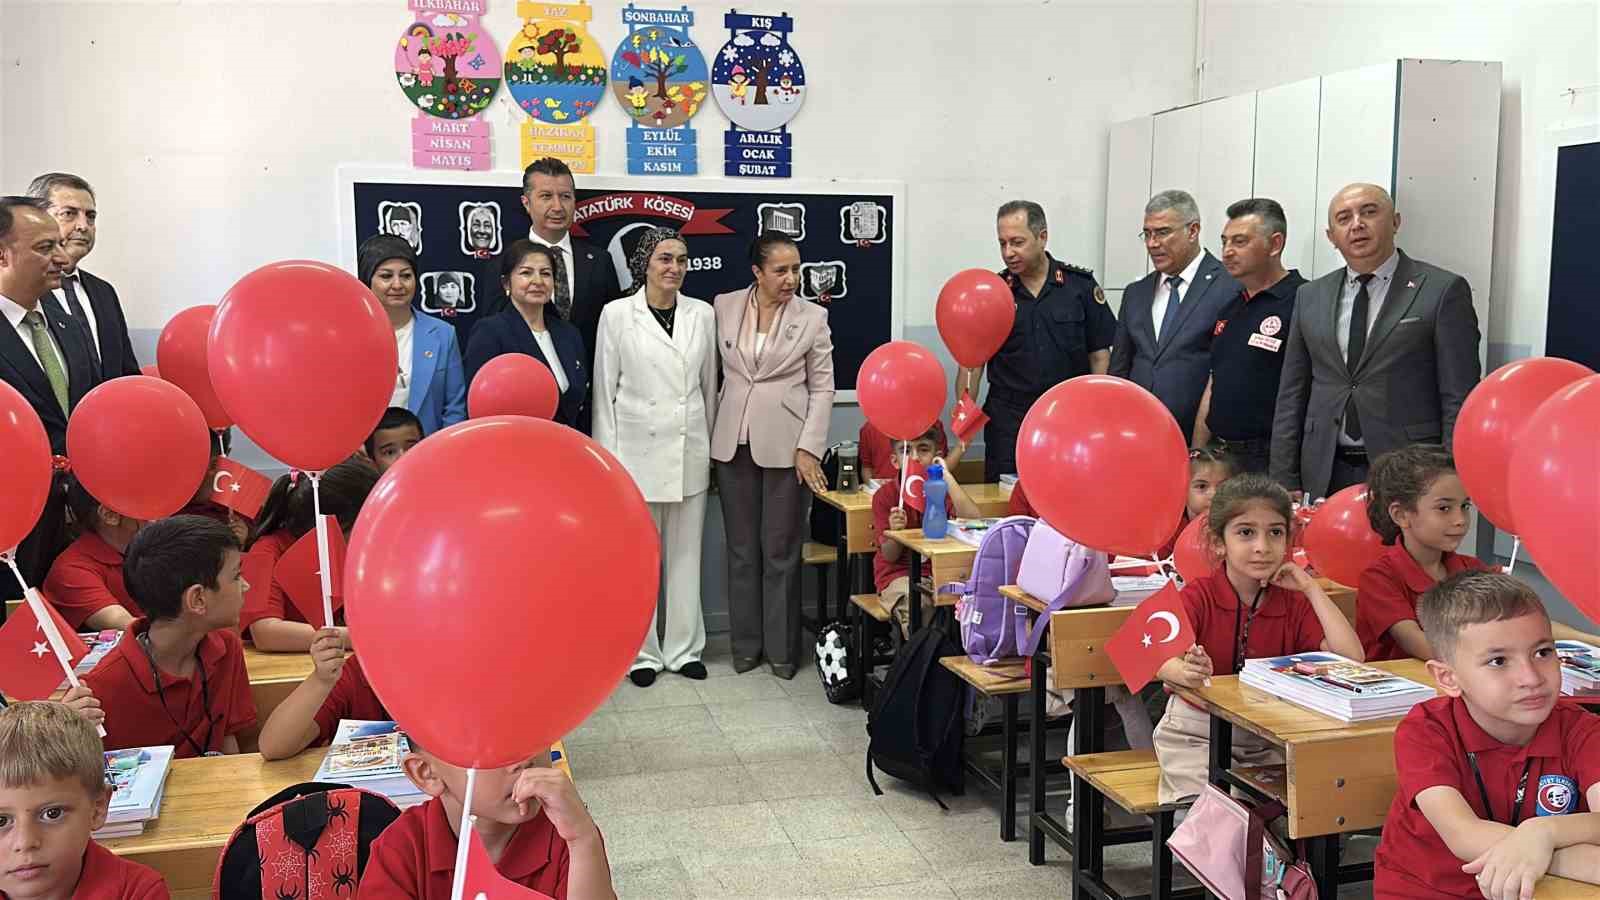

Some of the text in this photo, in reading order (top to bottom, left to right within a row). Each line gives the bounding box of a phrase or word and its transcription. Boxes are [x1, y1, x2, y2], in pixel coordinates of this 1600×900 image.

[624, 11, 690, 24] SONBAHAR
[751, 17, 773, 30] KIŞ
[431, 123, 470, 133] MART
[643, 128, 682, 141] EYLÜL
[739, 133, 783, 145] ARALIK
[430, 137, 472, 149] NİSAN
[647, 144, 677, 156] EKİM
[742, 149, 775, 160] OCAK
[431, 154, 472, 166] MAYIS
[643, 162, 682, 173] KASIM
[739, 164, 776, 176] ŞUBAT
[573, 196, 696, 223] ATATÜRK KÖŞESİ
